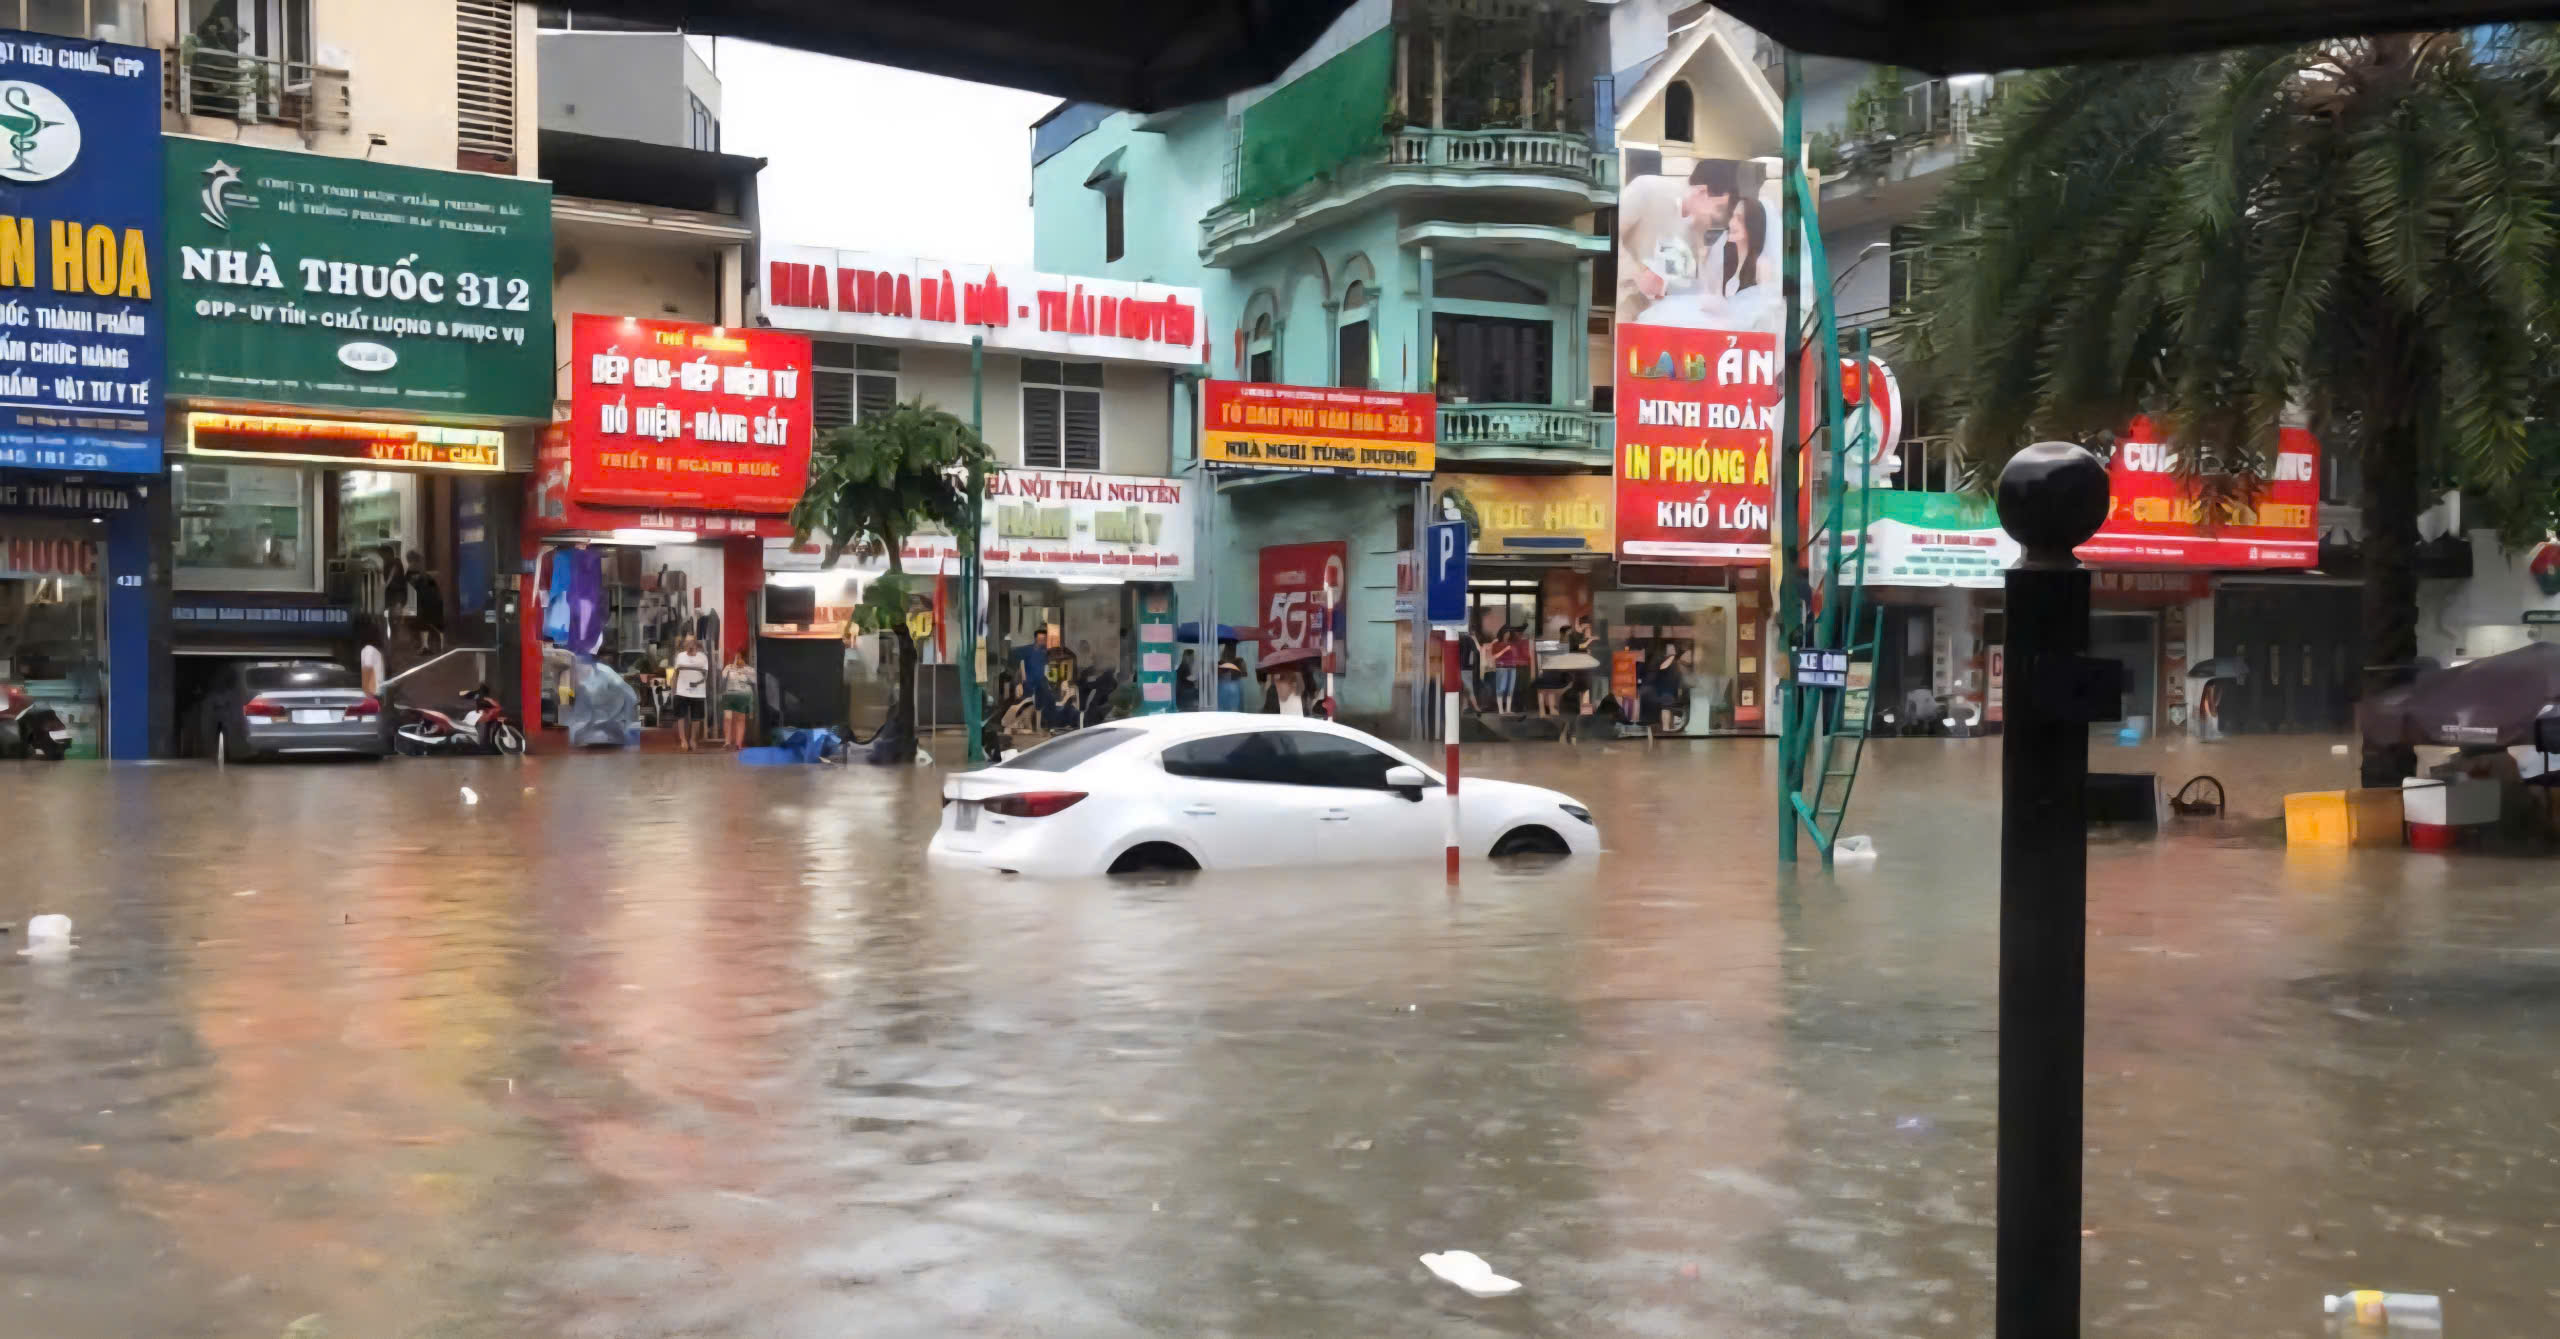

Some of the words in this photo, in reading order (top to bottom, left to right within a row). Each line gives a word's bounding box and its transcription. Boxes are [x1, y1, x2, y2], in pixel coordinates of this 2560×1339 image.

[51, 219, 153, 300] HOA
[181, 242, 285, 289] NHÀ
[299, 254, 445, 303] THUỐC
[456, 273, 531, 312] 312
[770, 260, 829, 311] NHA
[837, 266, 913, 318] KHOA
[1638, 397, 1701, 428] MINH
[1625, 443, 1652, 481] IN
[1018, 472, 1052, 503] NỘI
[1056, 473, 1103, 502] THÁI
[1107, 474, 1181, 504] NGUYÊN
[1656, 489, 1711, 528] KHỔ
[1718, 496, 1769, 531] LỚN
[1439, 527, 1455, 583] P
